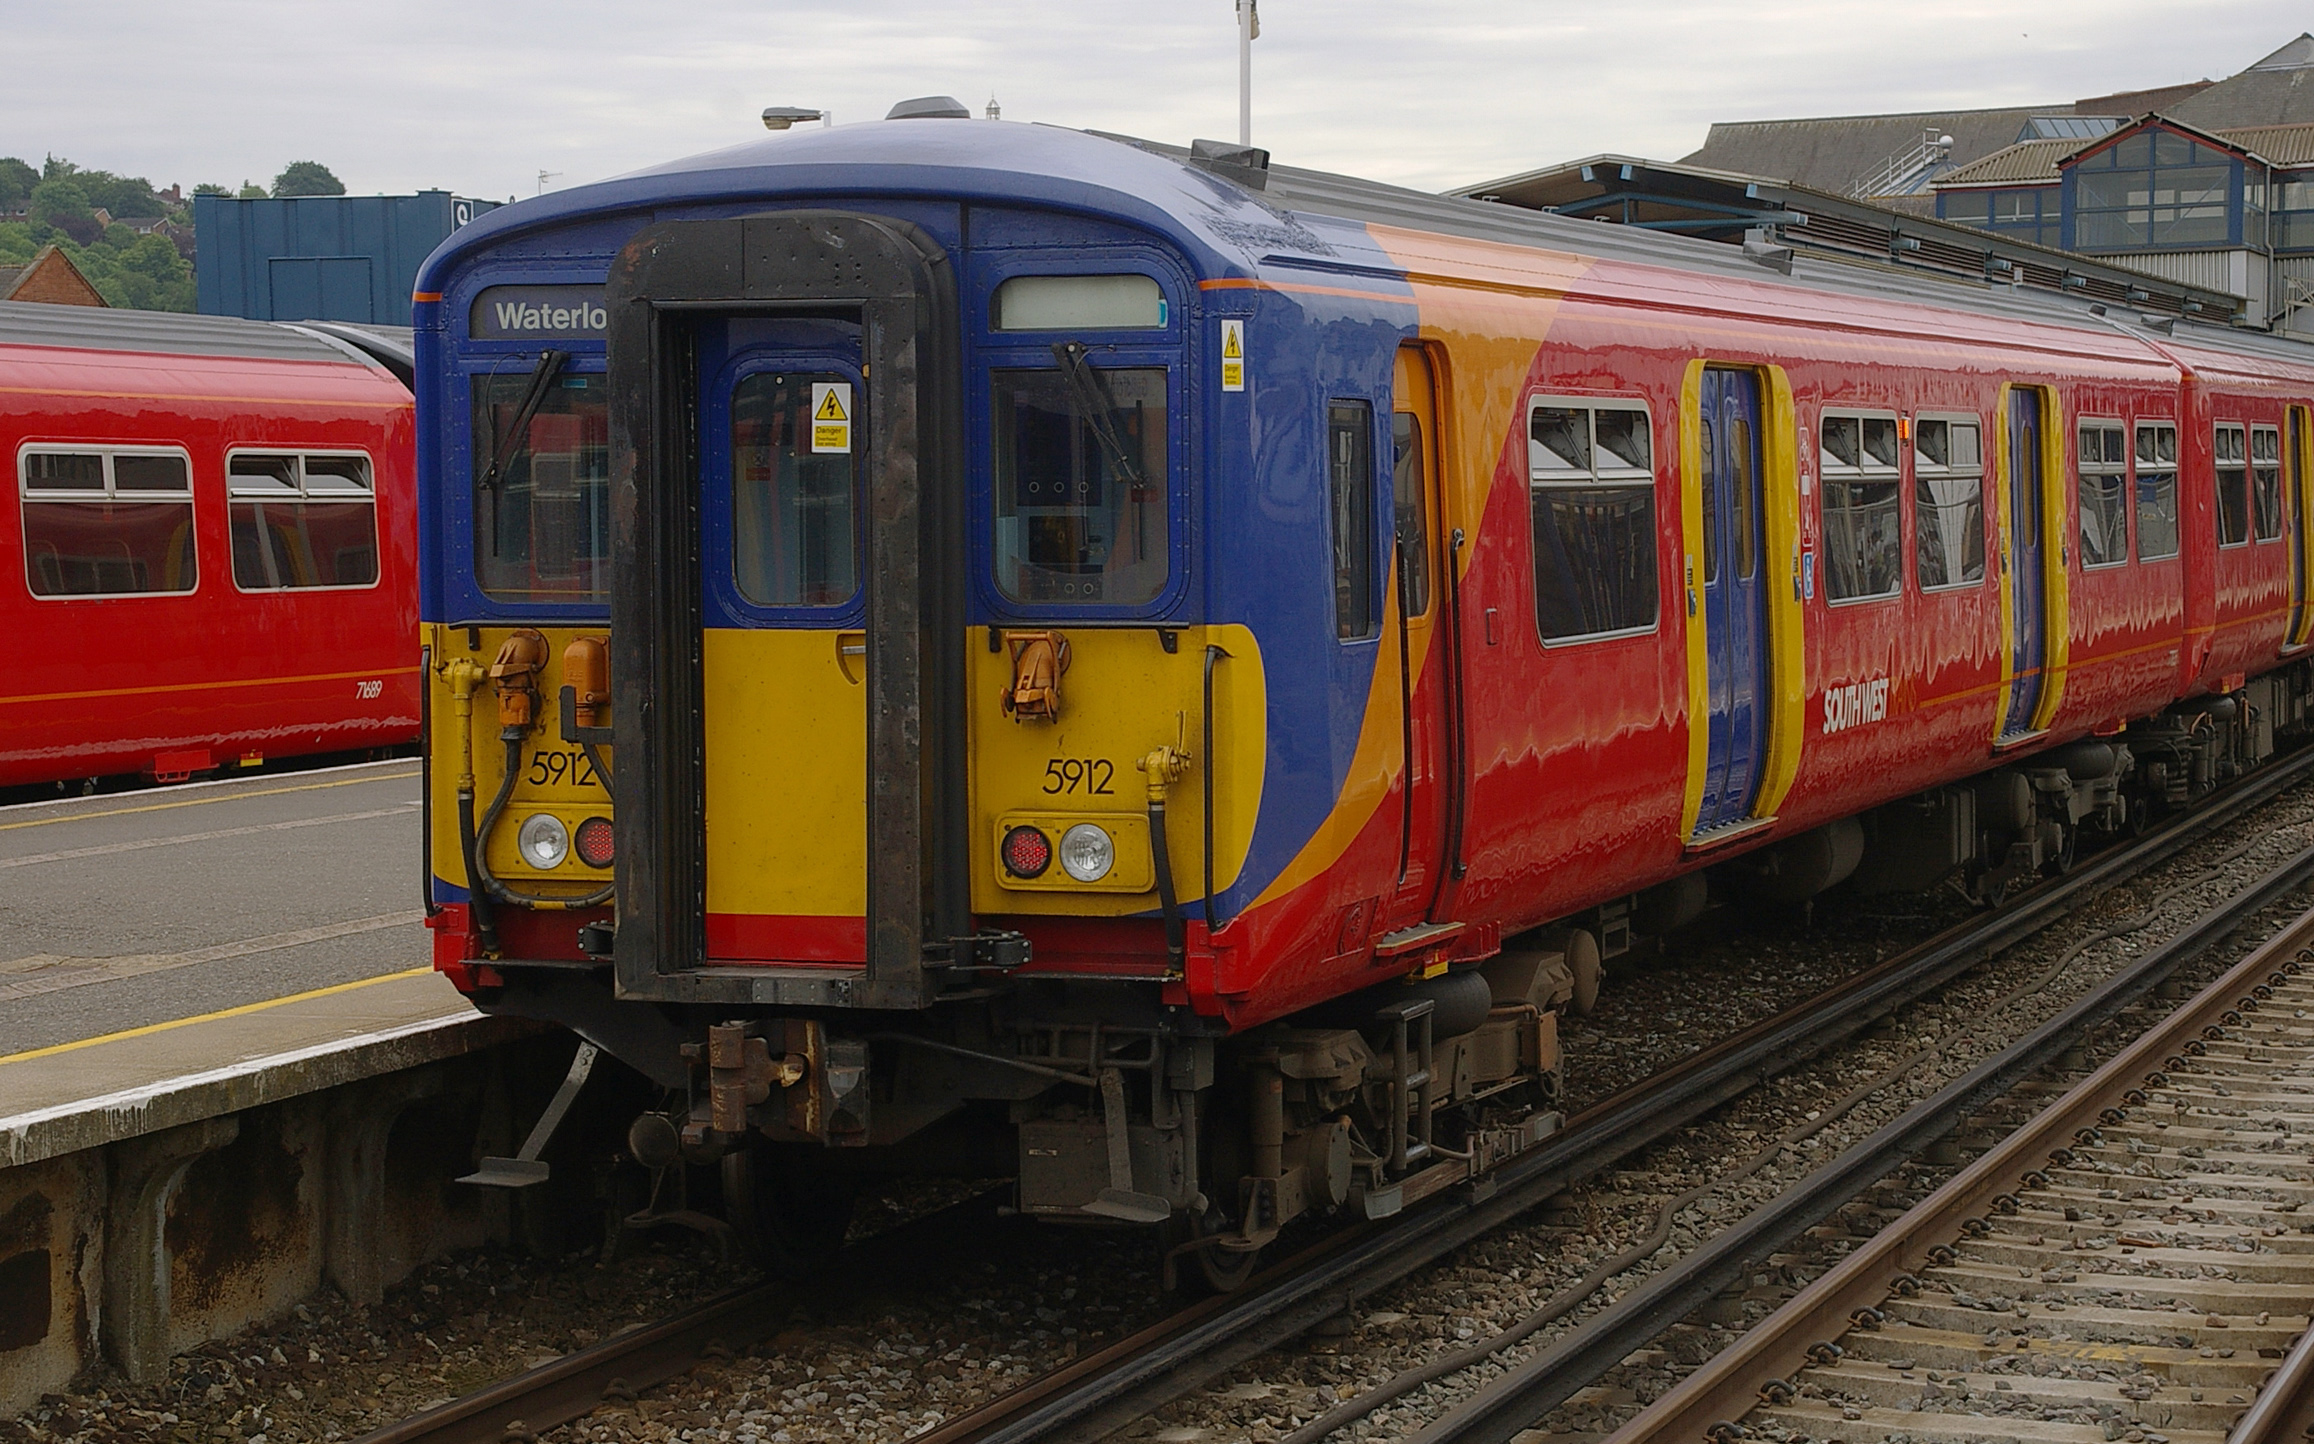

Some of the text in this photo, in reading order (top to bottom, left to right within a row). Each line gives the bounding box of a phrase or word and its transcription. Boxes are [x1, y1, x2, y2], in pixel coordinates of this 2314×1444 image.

[495, 301, 607, 330] Waterlo
[816, 426, 842, 435] Danger
[355, 680, 383, 700] 71689
[528, 751, 597, 786] 5912
[1042, 758, 1115, 795] 5912
